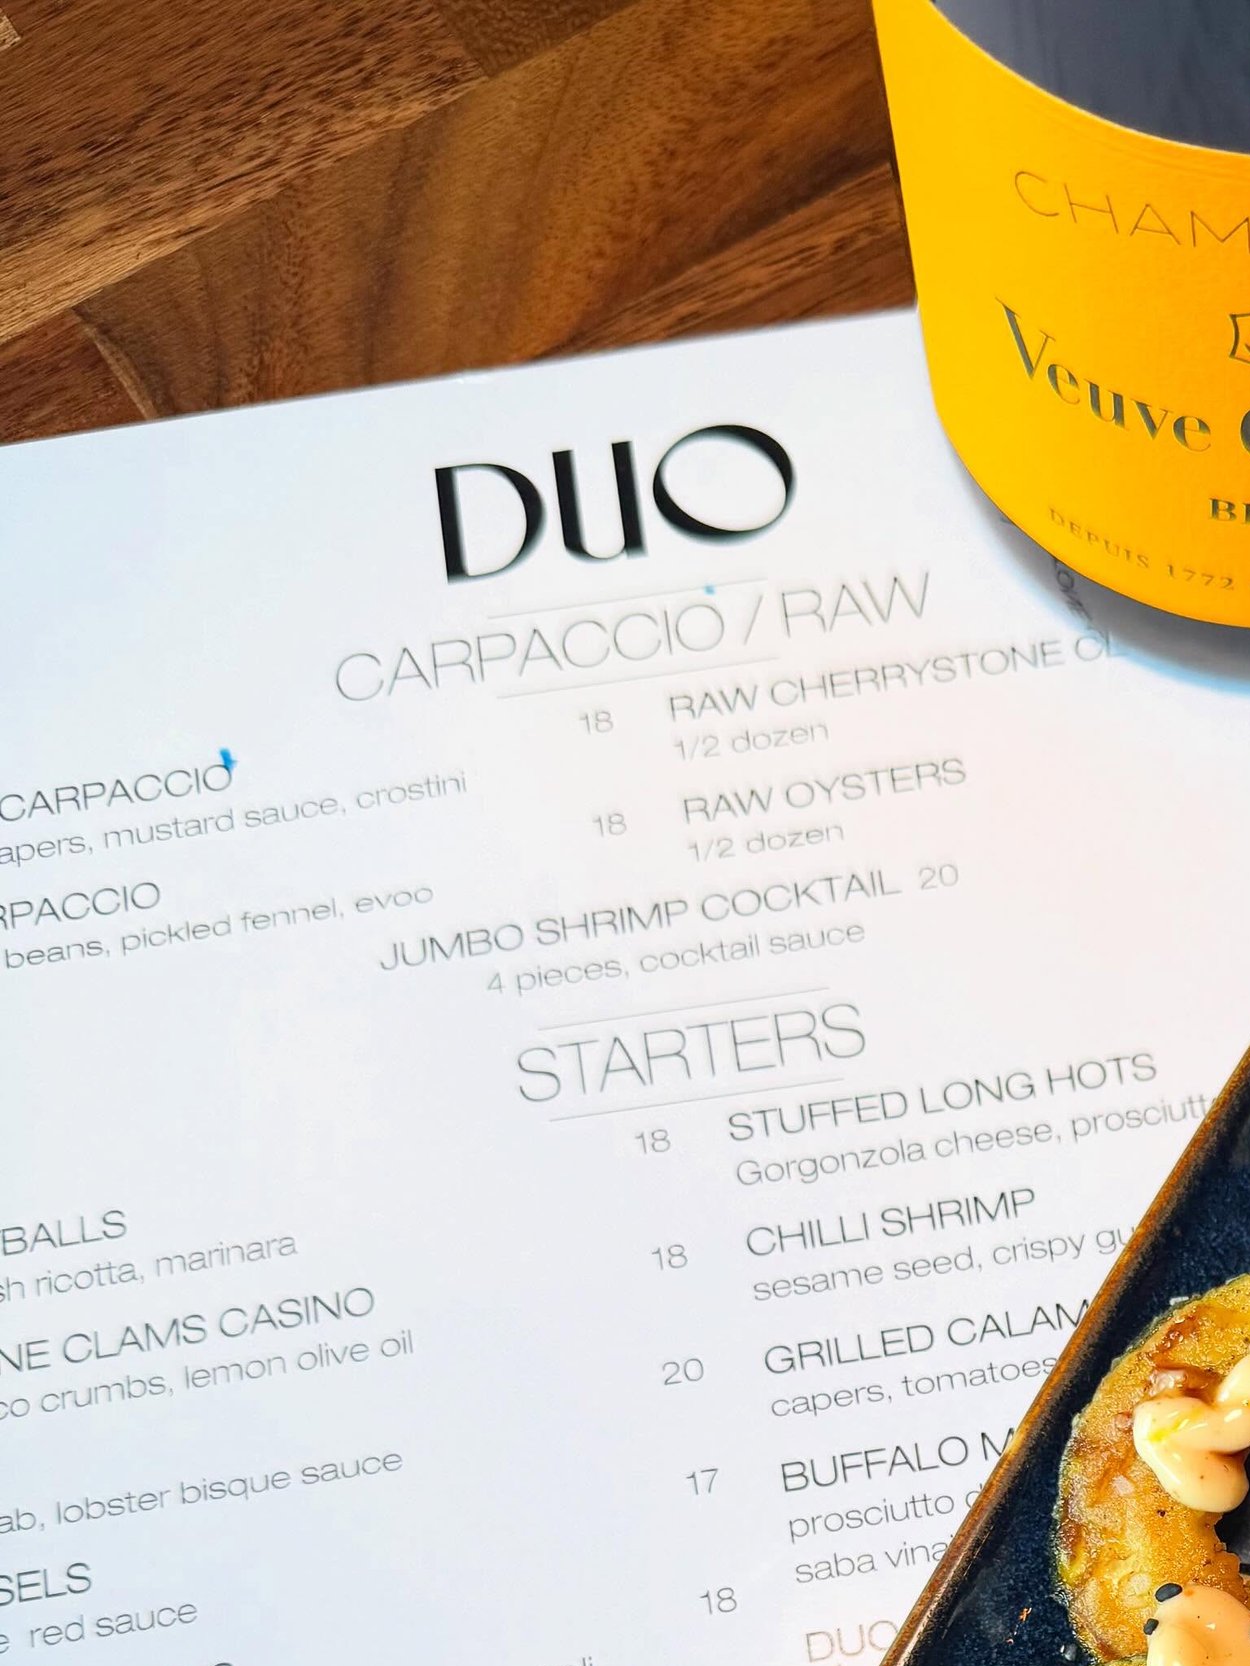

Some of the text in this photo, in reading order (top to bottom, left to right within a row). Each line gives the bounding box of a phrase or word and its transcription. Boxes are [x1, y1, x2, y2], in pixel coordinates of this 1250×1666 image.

[996, 297, 1211, 454] Veuve
[434, 424, 796, 584] DUO
[1050, 509, 1149, 568] DEPUIS
[1167, 564, 1234, 590] 1772
[335, 604, 724, 701] CARPACCIO
[781, 571, 929, 638] RAW
[669, 685, 758, 721] RAW
[770, 640, 1064, 706] CHERRYSTONE
[579, 710, 613, 734] 18
[673, 722, 829, 760] 1/2 dozen
[0, 764, 232, 821] CARPACCIO
[104, 808, 234, 848] mustard
[245, 798, 346, 827] sauce,
[356, 771, 466, 809] crostini
[683, 758, 966, 824] RAW OYSTERS
[592, 812, 627, 837] 18
[687, 824, 844, 862] 1/2 dozen
[5, 887, 433, 969] beans, pickled fennel, evoo
[380, 863, 959, 970] JUMBO SHRIMP COCKTAIL 20
[487, 925, 864, 996] 4 pieces, cocktail sauce
[516, 1003, 865, 1102] STARTERS
[729, 1053, 1157, 1141] STUFFED LONG HOTS
[635, 1129, 671, 1154] 18
[736, 1094, 1219, 1185] Gorgonzola cheese, prosciutt
[0, 1210, 126, 1256] BALLS
[747, 1188, 1035, 1256] CHILLI SHRIMP
[36, 1262, 144, 1296] ricotta,
[156, 1237, 298, 1277] marinara
[652, 1244, 688, 1270] 18
[753, 1265, 883, 1301] sesame
[894, 1245, 982, 1280] seed,
[993, 1234, 1085, 1265] crispy
[63, 1314, 207, 1363] CLAMS
[219, 1288, 374, 1338] CASINO
[765, 1325, 934, 1374] GRILLED
[40, 1375, 173, 1412] crumbs,
[185, 1356, 286, 1389] lemon
[297, 1343, 369, 1370] olive
[380, 1329, 413, 1357] oil
[662, 1358, 704, 1385] 20
[771, 1358, 1059, 1416] capers, tomatoes
[57, 1490, 170, 1524] lobster
[180, 1472, 291, 1504] bisque
[301, 1453, 402, 1484] sauce
[686, 1468, 718, 1495] 17
[781, 1436, 968, 1492] BUFFALO
[789, 1494, 954, 1544] prosciutto
[796, 1535, 954, 1583] saba vina
[30, 1615, 84, 1647] red
[96, 1604, 197, 1637] sauce
[700, 1587, 737, 1614] 18
[806, 1620, 898, 1662] DUO
